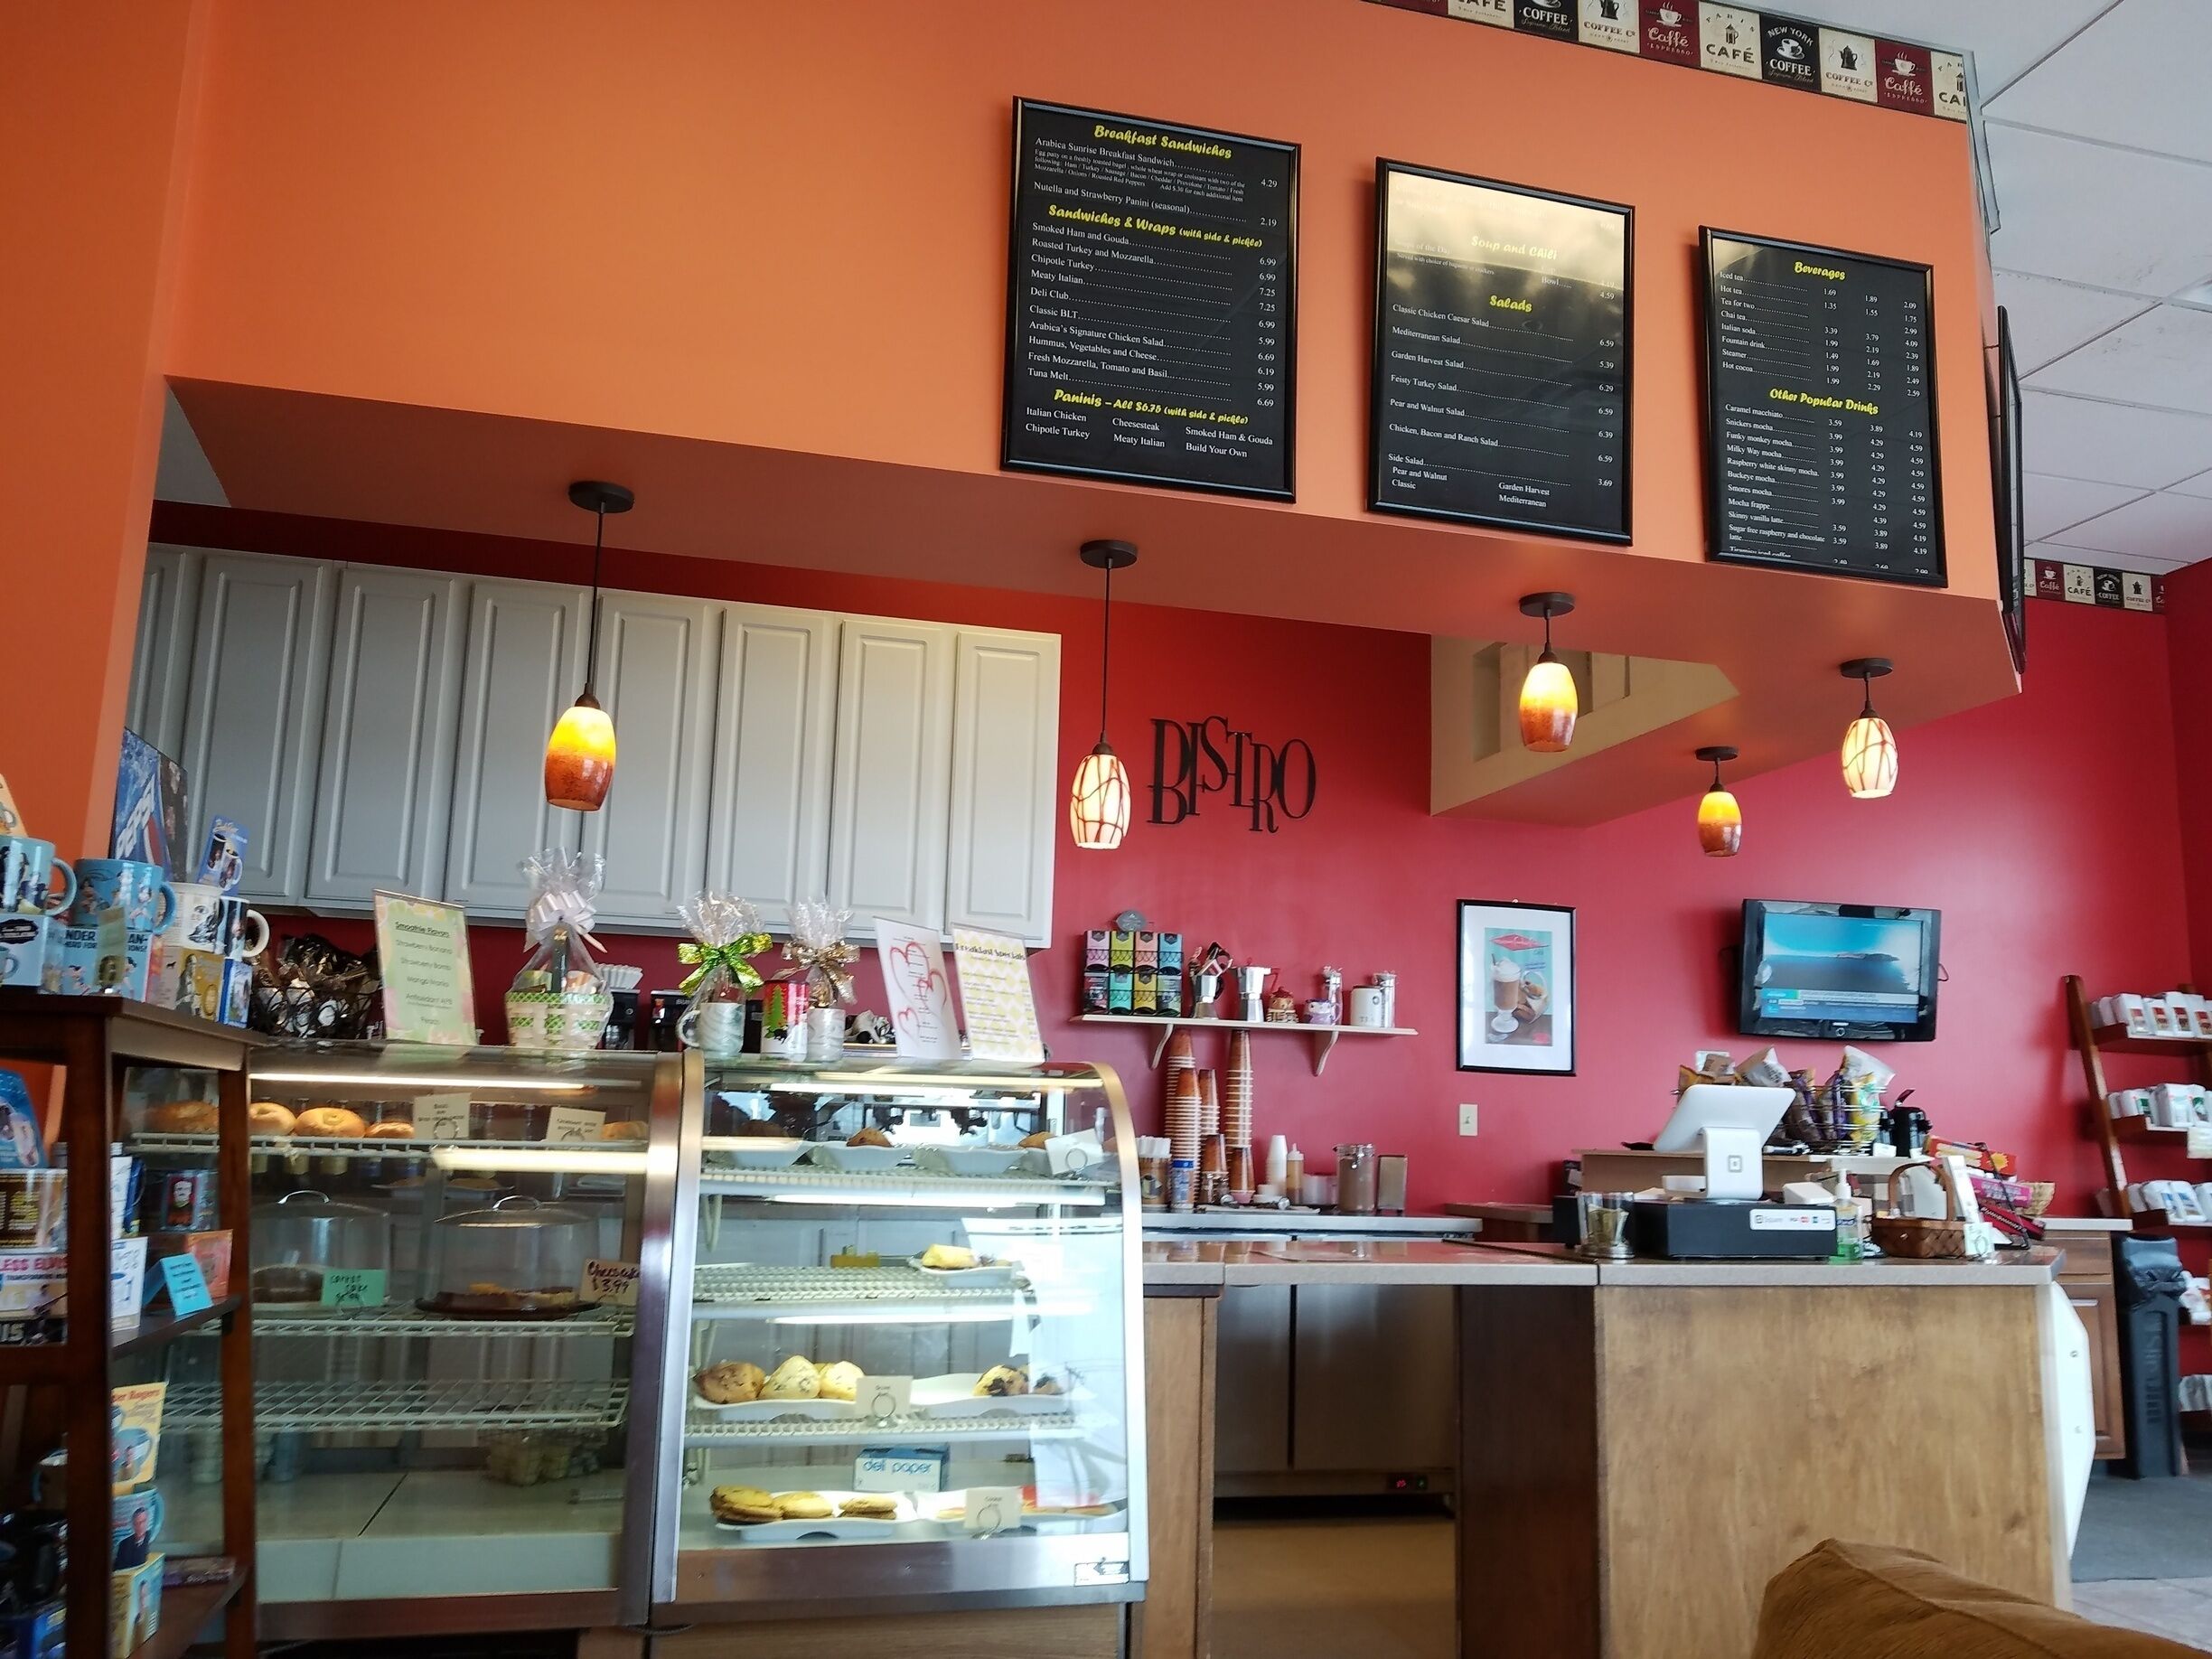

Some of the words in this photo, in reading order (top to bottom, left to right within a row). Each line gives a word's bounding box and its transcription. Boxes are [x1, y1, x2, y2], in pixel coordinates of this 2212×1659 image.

[1523, 6, 1569, 25] COFFEE
[1584, 21, 1623, 35] COFFEE
[1767, 26, 1788, 37] NEW
[1790, 27, 1814, 47] YORK
[1706, 43, 1755, 63] CAFÉ
[1770, 58, 1812, 76] COFFEE
[1825, 71, 1861, 85] COFFEE
[1094, 125, 1157, 145] Breakfast
[1160, 136, 1232, 159] Sandwiches
[1036, 137, 1066, 149] Arabica
[1068, 143, 1097, 155] Sunrise
[1100, 147, 1135, 161] Breakfast
[1138, 154, 1174, 167] Sandwich
[1261, 179, 1278, 187] 4.29
[1035, 182, 1063, 193] Nutella
[1064, 188, 1079, 196] and
[1081, 189, 1123, 204] Strawberry
[1126, 196, 1149, 207] Panini
[1151, 201, 1190, 214] (seasonal)
[1261, 217, 1277, 227] 2.19
[1049, 204, 1120, 227] Sandwiches
[1124, 217, 1132, 228] &
[1137, 218, 1176, 235] Wraps
[1179, 228, 1202, 239] (with
[1204, 232, 1222, 241] side
[1223, 234, 1230, 243] &
[1233, 237, 1262, 248] pickle)
[1033, 222, 1064, 235] Smoked
[1067, 228, 1085, 238] Ham
[1087, 232, 1101, 240] and
[1103, 234, 1129, 245] Gouda
[1260, 258, 1276, 266] 6.99
[1471, 235, 1500, 251] Soup
[1503, 243, 1525, 255] and
[1031, 254, 1065, 268] Chipotle
[1067, 259, 1094, 272] Turkey
[1260, 287, 1275, 296] 7.25
[1542, 276, 1560, 286] Bowl
[1795, 261, 1845, 280] Beverages
[1720, 271, 1734, 279] Iced
[1866, 295, 1878, 303] 1.89
[1904, 301, 1917, 309] 2.09
[1720, 285, 1731, 293] Hot
[1824, 302, 1837, 310] 1.35
[1490, 295, 1532, 312] Salads
[1029, 305, 1058, 316] Classic
[1061, 309, 1078, 318] BLT
[1259, 337, 1275, 346] 5.99
[1392, 304, 1417, 315] Classic
[1418, 309, 1446, 319] Chicken
[1448, 314, 1470, 323] Caesar
[1472, 317, 1489, 327] Salad
[1599, 339, 1614, 347] 6.59
[1720, 310, 1735, 318] Chai
[1824, 326, 1838, 334] 3.39
[1070, 326, 1107, 341] Signature
[1108, 332, 1140, 343] Chicken
[1142, 336, 1164, 347] Salad
[1258, 352, 1274, 361] 6.69
[1722, 335, 1748, 346] Fountain
[1749, 340, 1766, 348] drink
[1392, 351, 1416, 361] Garden
[1418, 355, 1443, 365] Harvest
[1445, 360, 1464, 369] Salad
[1027, 368, 1047, 378] Tuna
[1050, 370, 1068, 380] Melt
[1257, 398, 1274, 407] 6.69
[1391, 374, 1411, 386] Feisty
[1412, 378, 1437, 390] Turkey
[1438, 382, 1457, 391] Salad
[1054, 389, 1101, 407] Paninis
[1113, 399, 1132, 411] All
[1164, 407, 1186, 417] (with
[1189, 410, 1207, 419] side
[1209, 412, 1215, 420] &
[1217, 414, 1248, 425] pickle)
[1770, 389, 1797, 401] Other
[1800, 393, 1843, 408] Popular
[1845, 399, 1879, 415] Drinks
[1112, 417, 1160, 431] Cheesesteak
[1725, 404, 1751, 414] Caramel
[1752, 409, 1783, 418] macchiato
[1870, 425, 1883, 433] 3.89
[1186, 443, 1207, 452] Build
[1209, 445, 1227, 455] Your
[1229, 448, 1247, 457] Own
[1420, 428, 1442, 437] Bacon
[1457, 434, 1479, 443] Ranch
[1480, 437, 1498, 446] Salad
[1598, 455, 1613, 463] 6.59
[1727, 431, 1745, 442] Funky
[1747, 436, 1771, 445] monkey
[1772, 439, 1794, 447] mocha
[1830, 445, 1843, 454] 3.99
[1388, 454, 1403, 463] Side
[1405, 456, 1424, 465] Salad
[1598, 478, 1613, 487] 3.69
[1499, 494, 1546, 507] Mediterranean
[1729, 511, 1748, 520] Skinny
[1750, 515, 1770, 524] vanilla
[1771, 516, 1786, 524] latte
[1147, 716, 1317, 833] BISTRO
[862, 1458, 886, 1472] deli
[891, 1461, 933, 1476] paper
